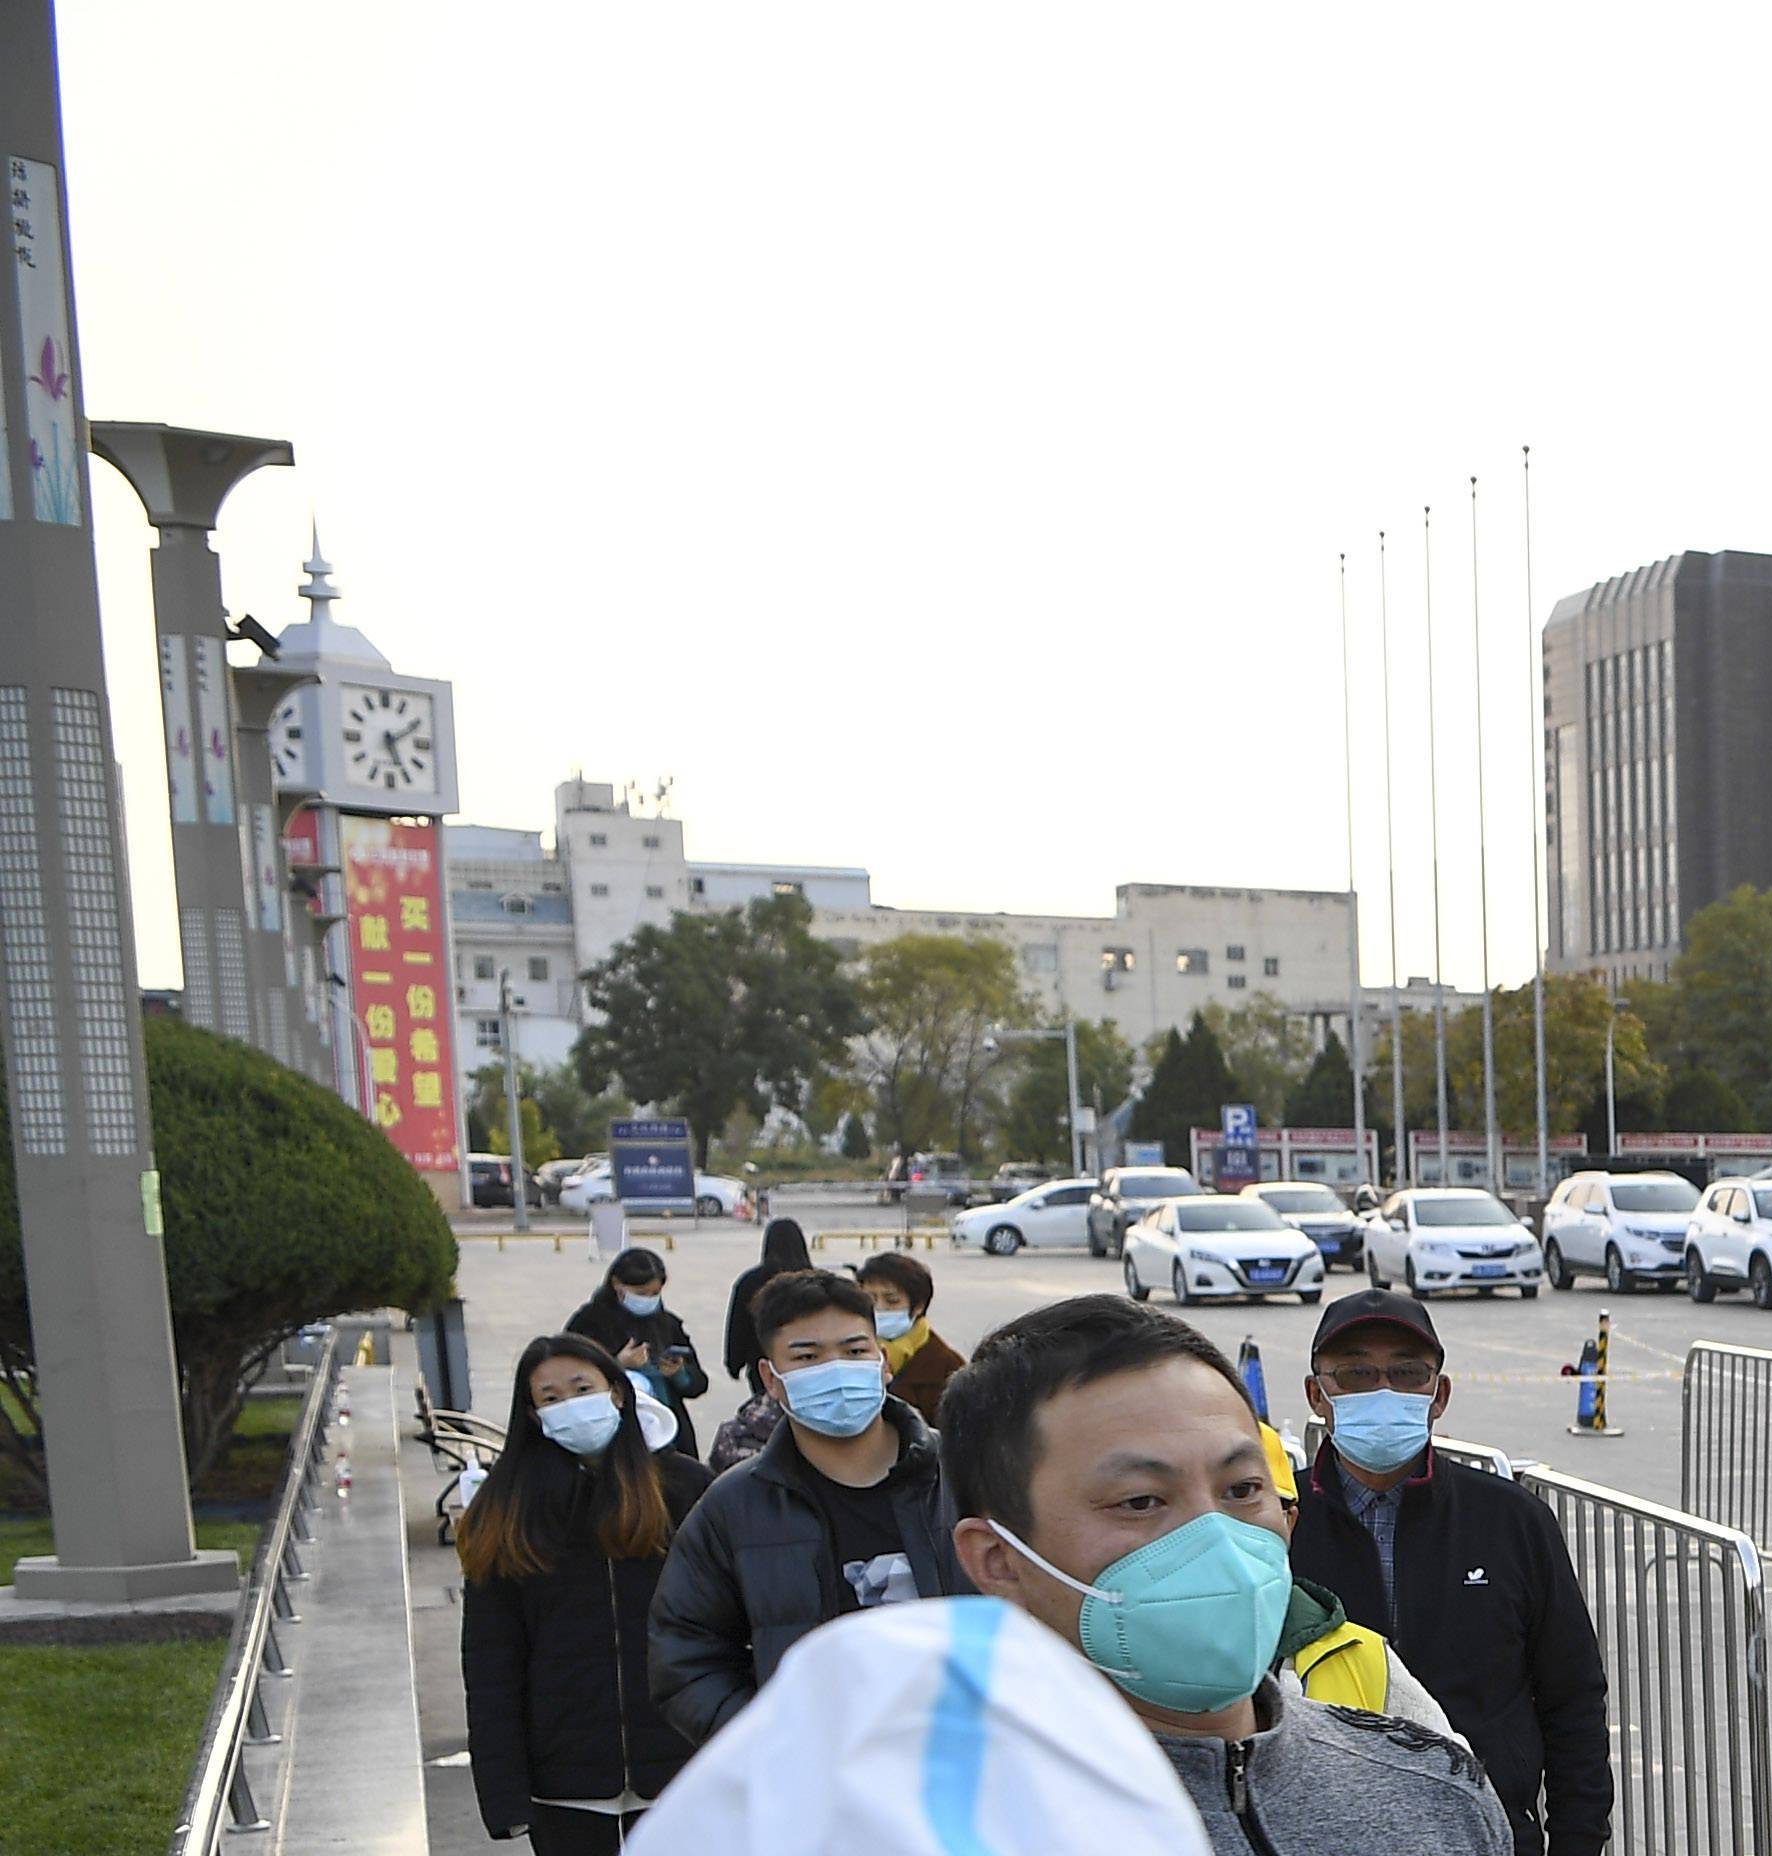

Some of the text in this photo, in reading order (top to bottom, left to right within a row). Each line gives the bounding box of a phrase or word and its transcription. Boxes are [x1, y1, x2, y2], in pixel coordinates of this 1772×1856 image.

[400, 895, 443, 1107] 买一份希望
[1227, 1108, 1249, 1133] P
